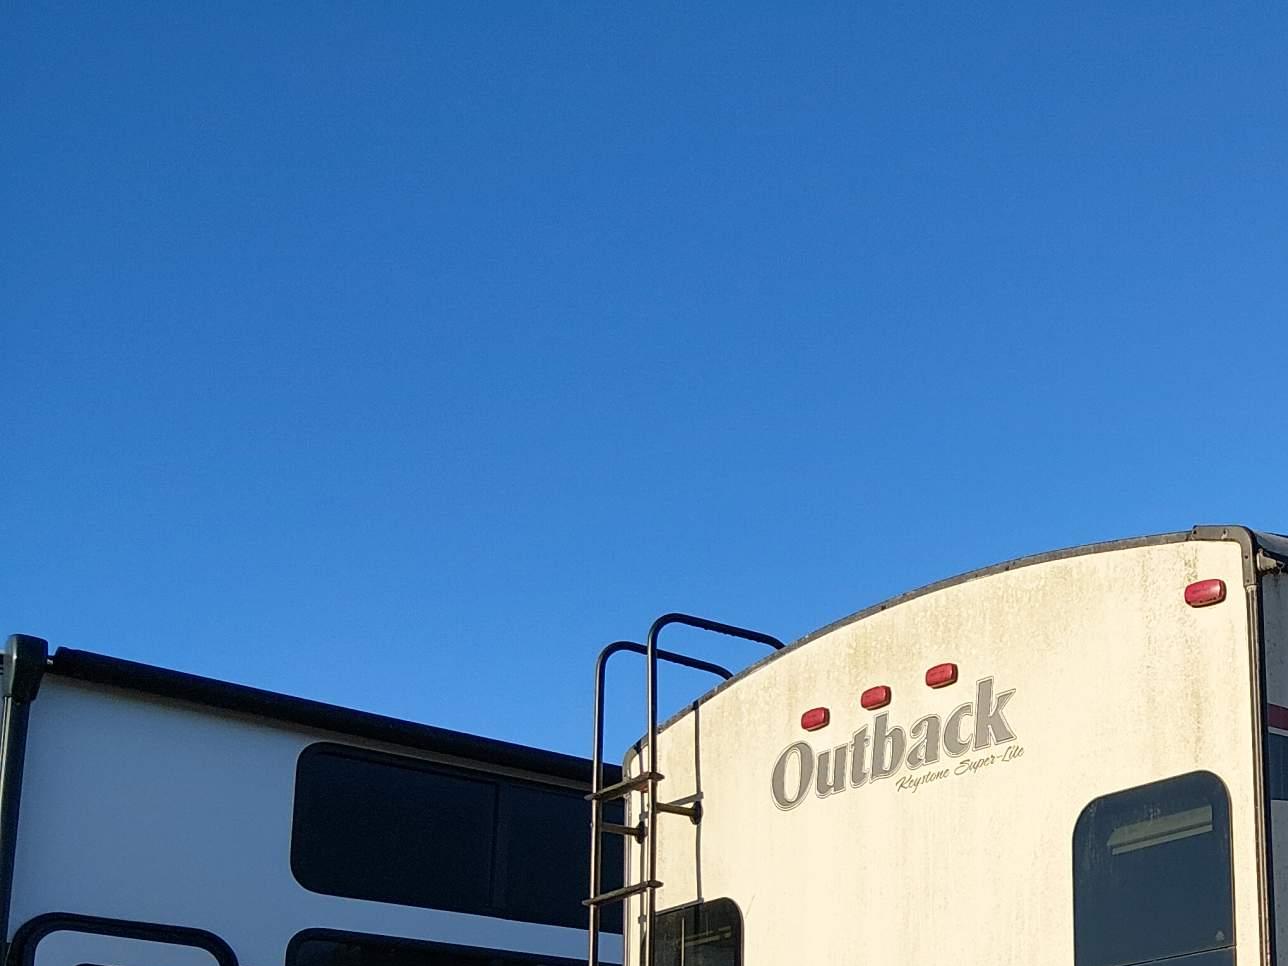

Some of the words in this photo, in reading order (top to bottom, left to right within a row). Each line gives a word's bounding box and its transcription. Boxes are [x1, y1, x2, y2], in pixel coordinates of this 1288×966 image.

[771, 676, 1017, 811] Outback
[896, 769, 949, 793] Keystone
[954, 745, 1025, 775] Super-Lite
